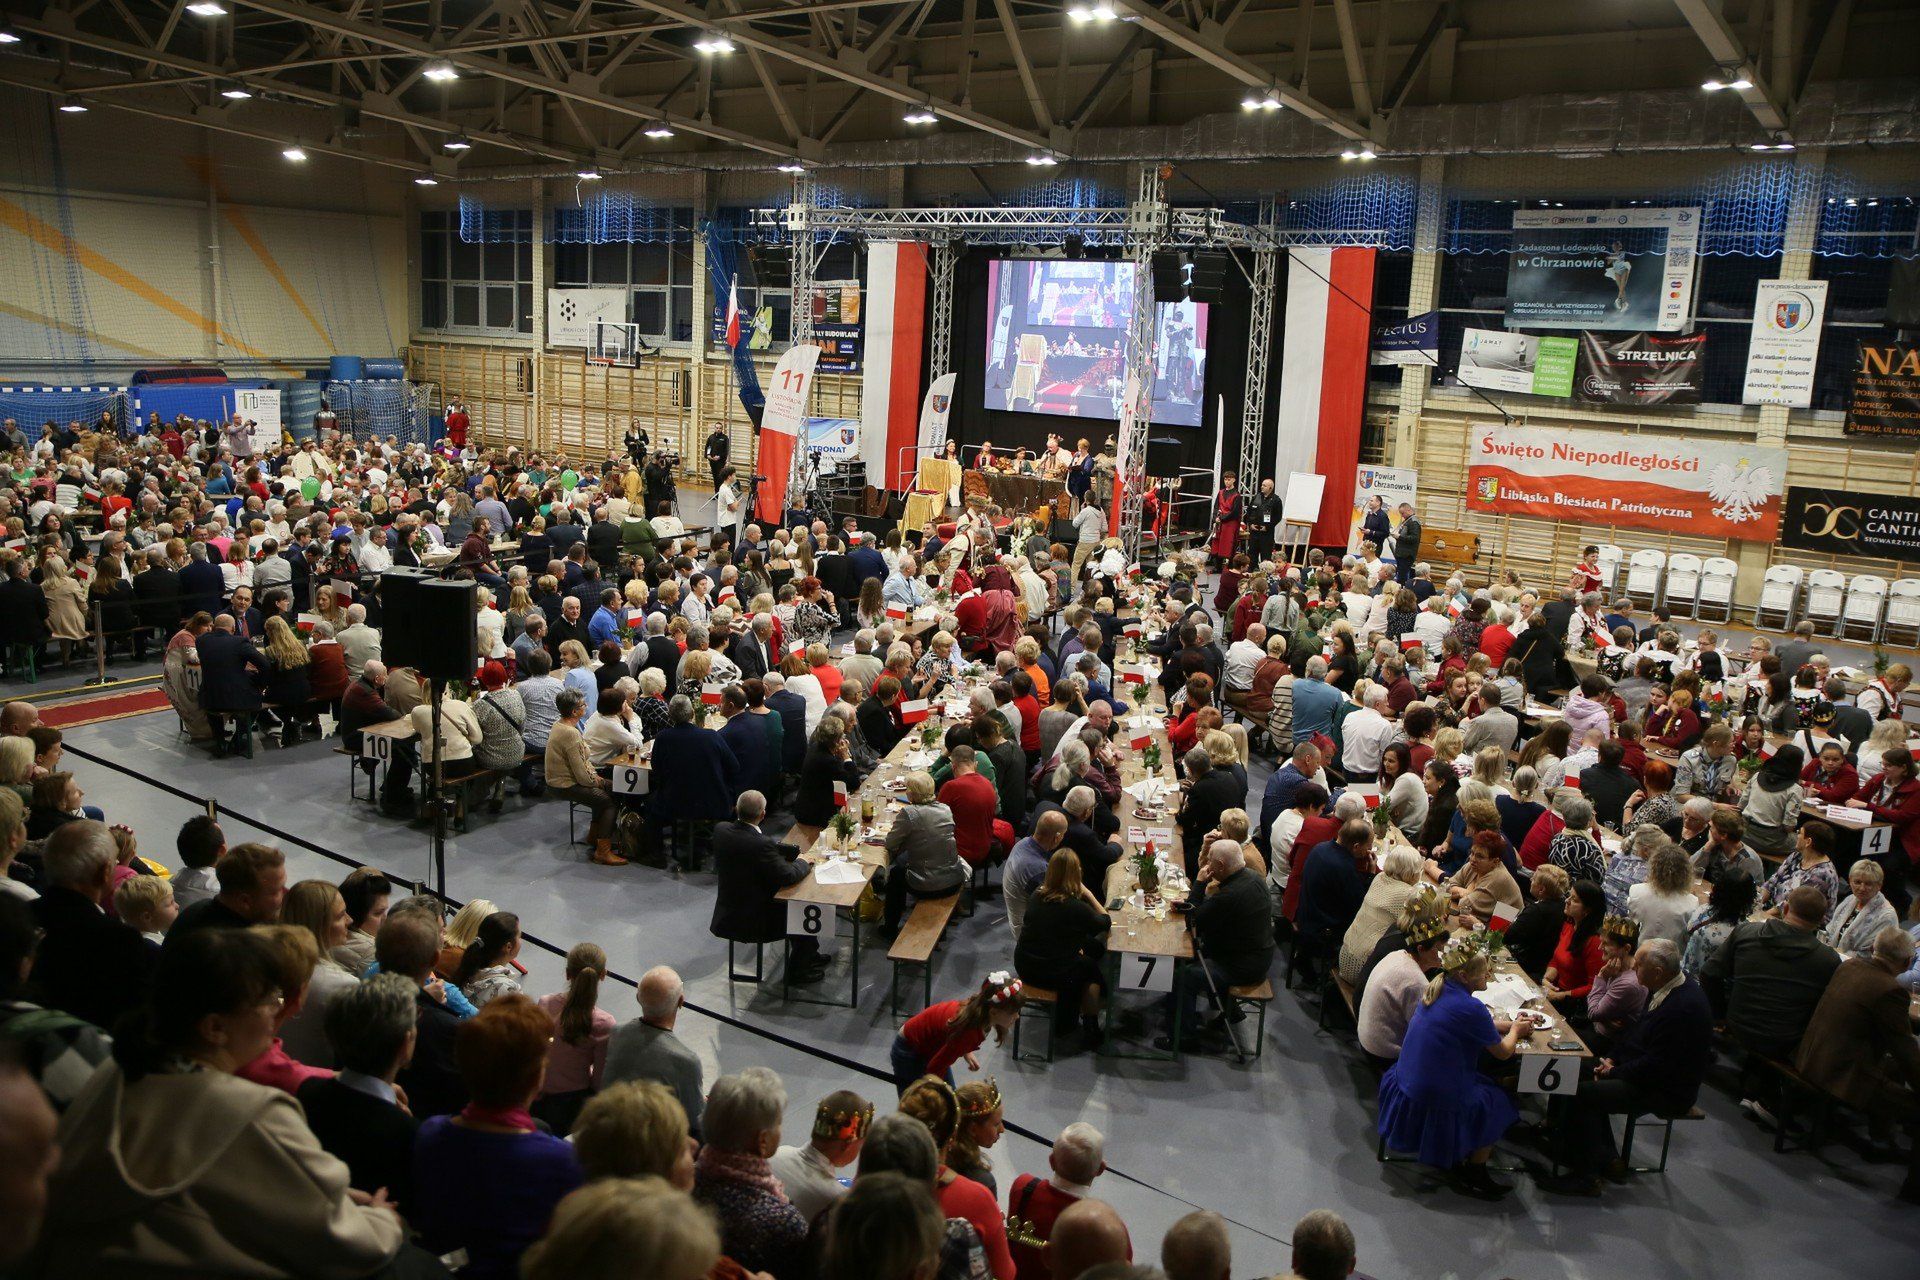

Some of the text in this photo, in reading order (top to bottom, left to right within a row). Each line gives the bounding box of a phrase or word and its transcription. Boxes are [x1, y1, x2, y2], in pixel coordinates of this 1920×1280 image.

[1518, 243, 1607, 252] Zadaszone Lodowisko
[1531, 257, 1605, 268] Chrzanowie
[1617, 350, 1697, 361] STRZELNICA
[781, 370, 804, 394] 11
[1857, 378, 1917, 388] RESTAURACJA
[1856, 389, 1888, 398] POKOJE
[1853, 401, 1892, 410] IMPREZY
[1481, 432, 1699, 472] Święto Niepodległości
[1375, 472, 1395, 480] Powiat
[1374, 481, 1412, 491] Chrzanowski
[1500, 487, 1693, 519] Libiąska Biesiada Patriotyczna
[1866, 522, 1920, 536] CANTI
[367, 735, 388, 759] 10
[625, 768, 638, 792] 9
[1869, 829, 1882, 852] 4
[803, 904, 822, 934] 8
[1138, 956, 1156, 988] 7
[1538, 1058, 1561, 1091] 6
